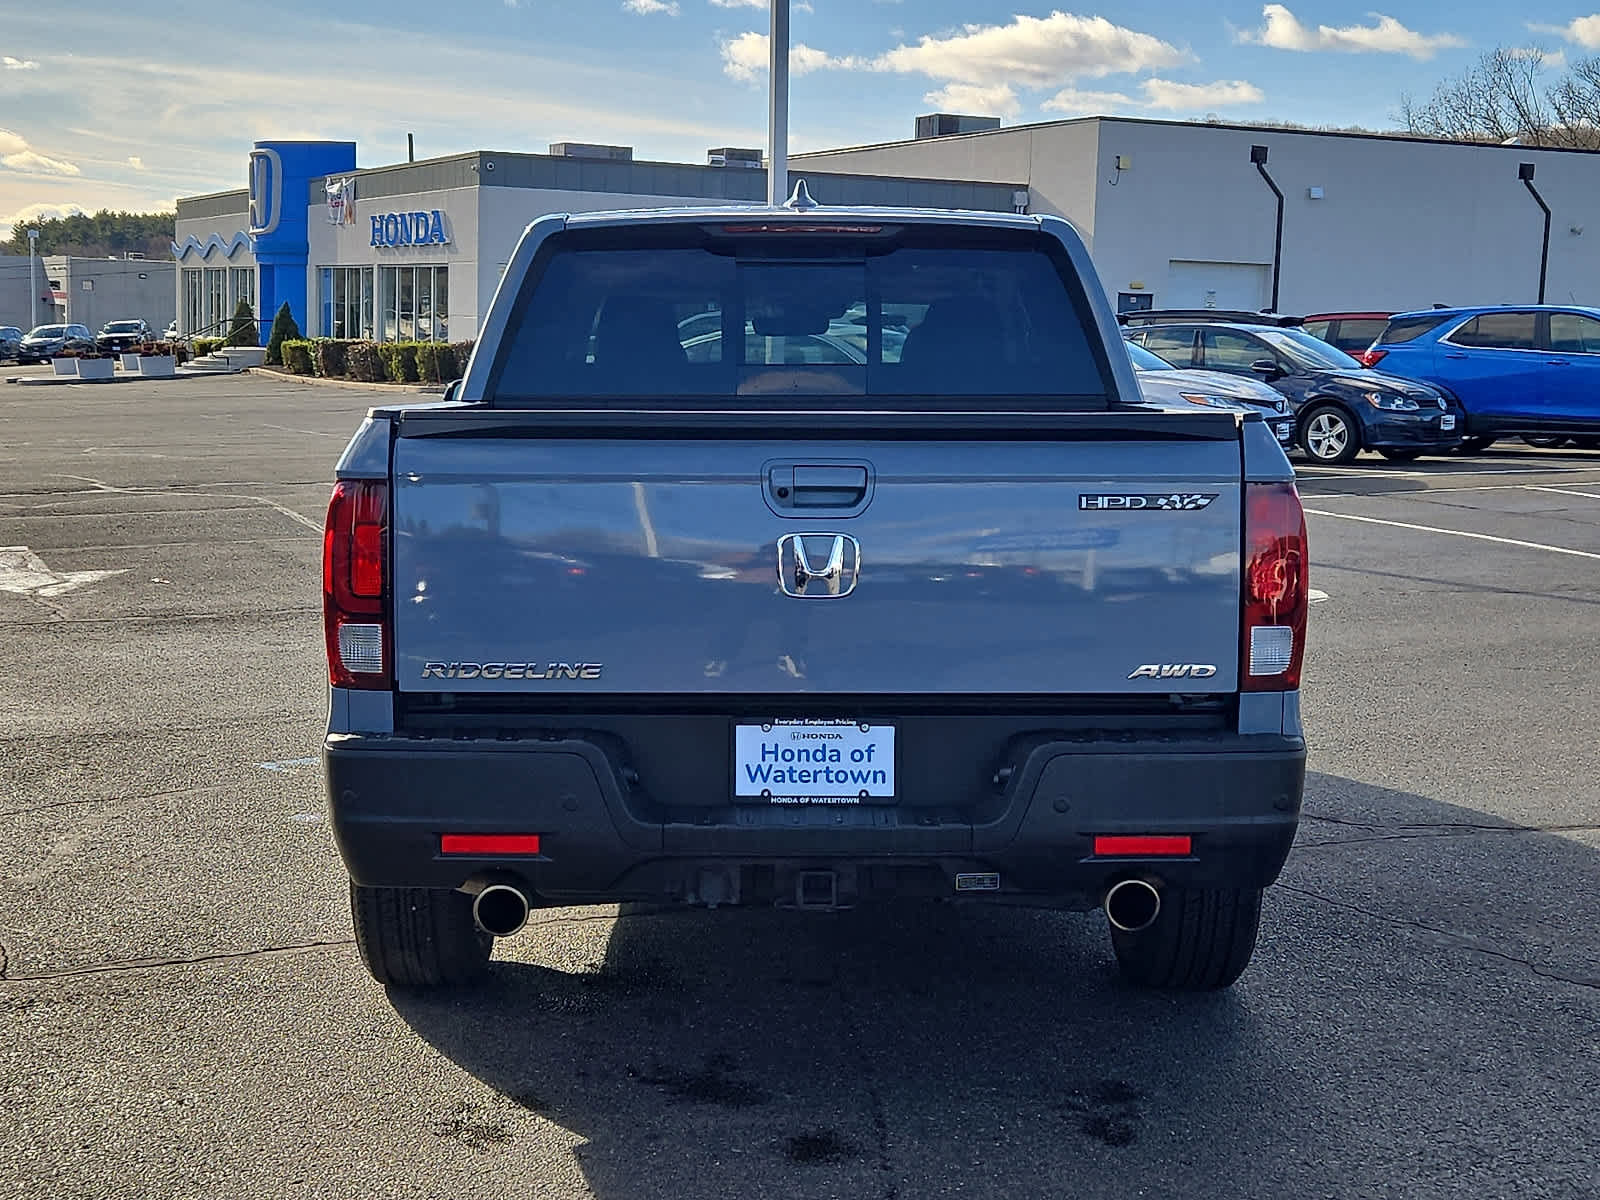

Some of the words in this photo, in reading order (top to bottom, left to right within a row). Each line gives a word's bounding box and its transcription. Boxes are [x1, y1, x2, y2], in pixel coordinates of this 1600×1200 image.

[369, 209, 447, 247] HONDA
[1081, 496, 1147, 509] HPD
[421, 662, 603, 679] RIDGELINE
[1127, 664, 1217, 679] AWD
[774, 718, 804, 726] Everyday
[804, 718, 835, 726] Employee
[835, 718, 857, 726] Pricing
[761, 743, 841, 763] Honda
[850, 743, 876, 763] of
[745, 763, 886, 784] Watertown
